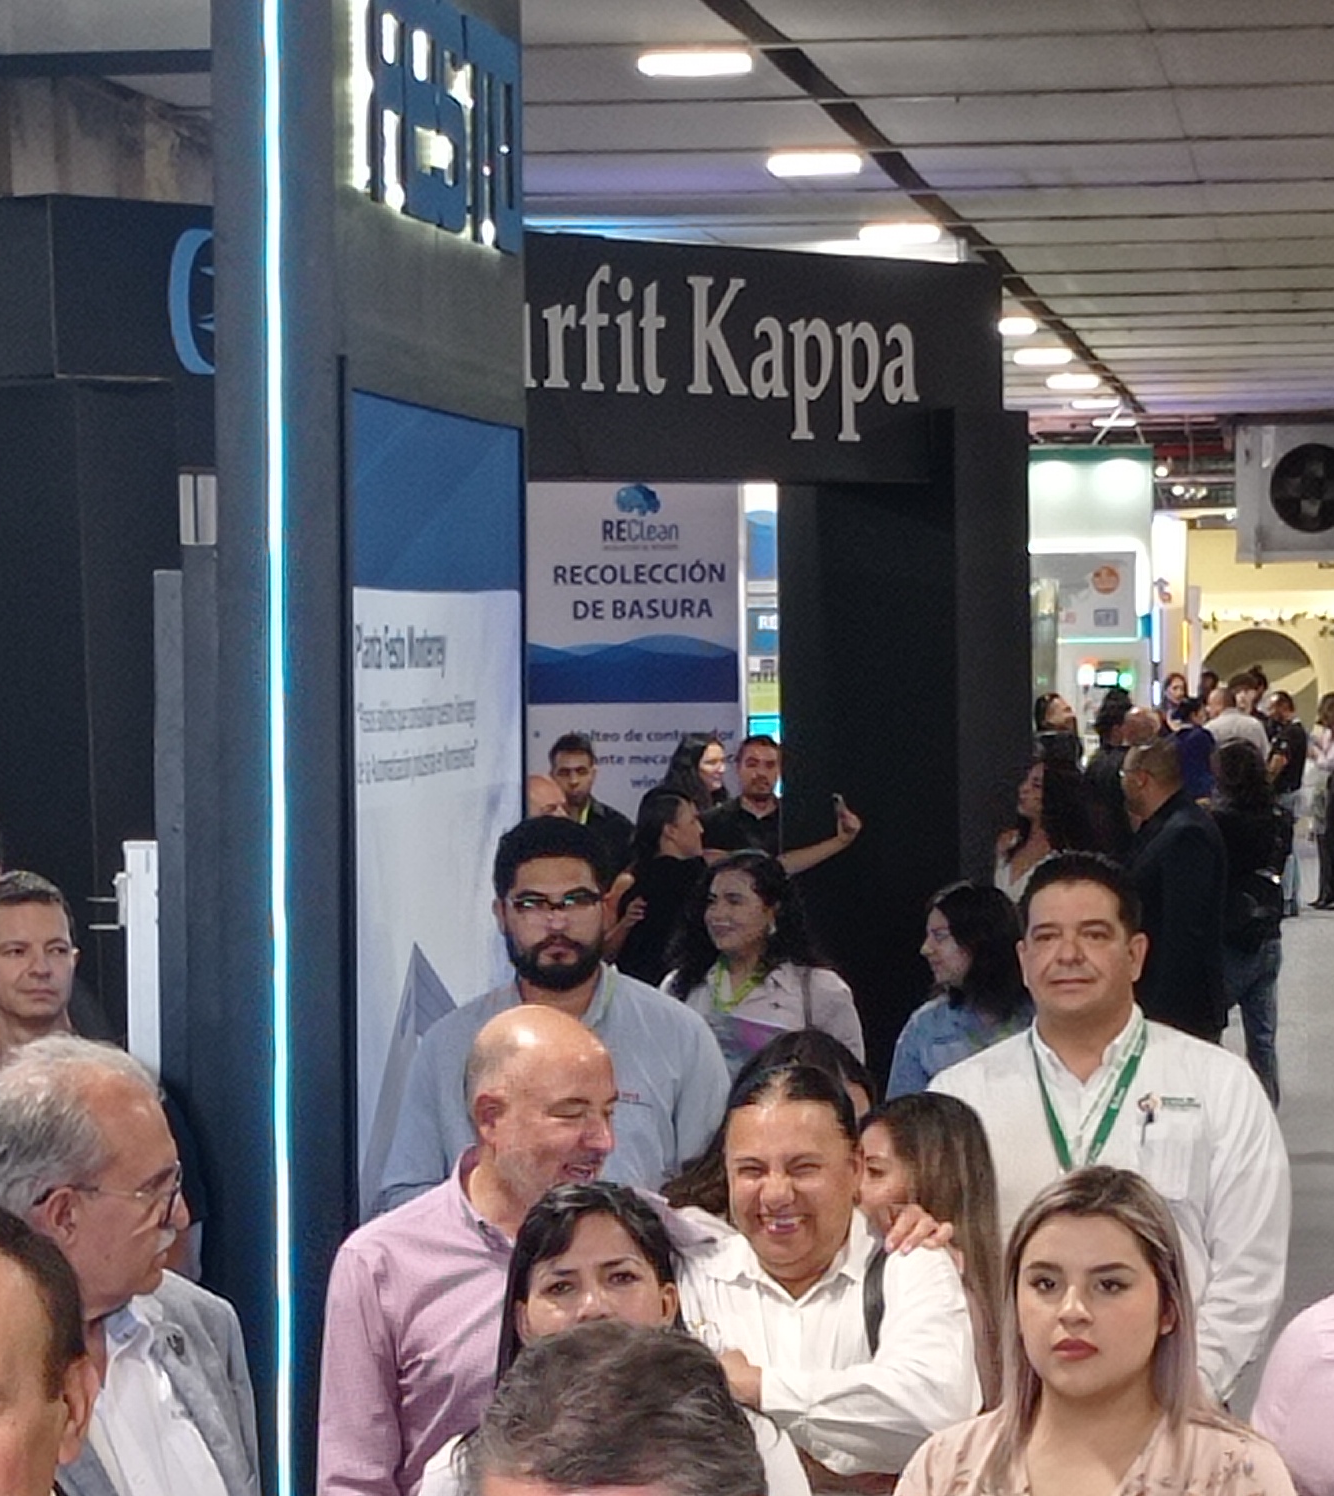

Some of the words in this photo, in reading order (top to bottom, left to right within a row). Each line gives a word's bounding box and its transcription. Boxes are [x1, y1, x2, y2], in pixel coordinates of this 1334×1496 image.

[687, 275, 920, 442] Kappa
[602, 518, 679, 542] REClean
[553, 558, 726, 585] RECOLECCIÓN
[573, 600, 605, 620] DE
[612, 598, 714, 620] BASURA
